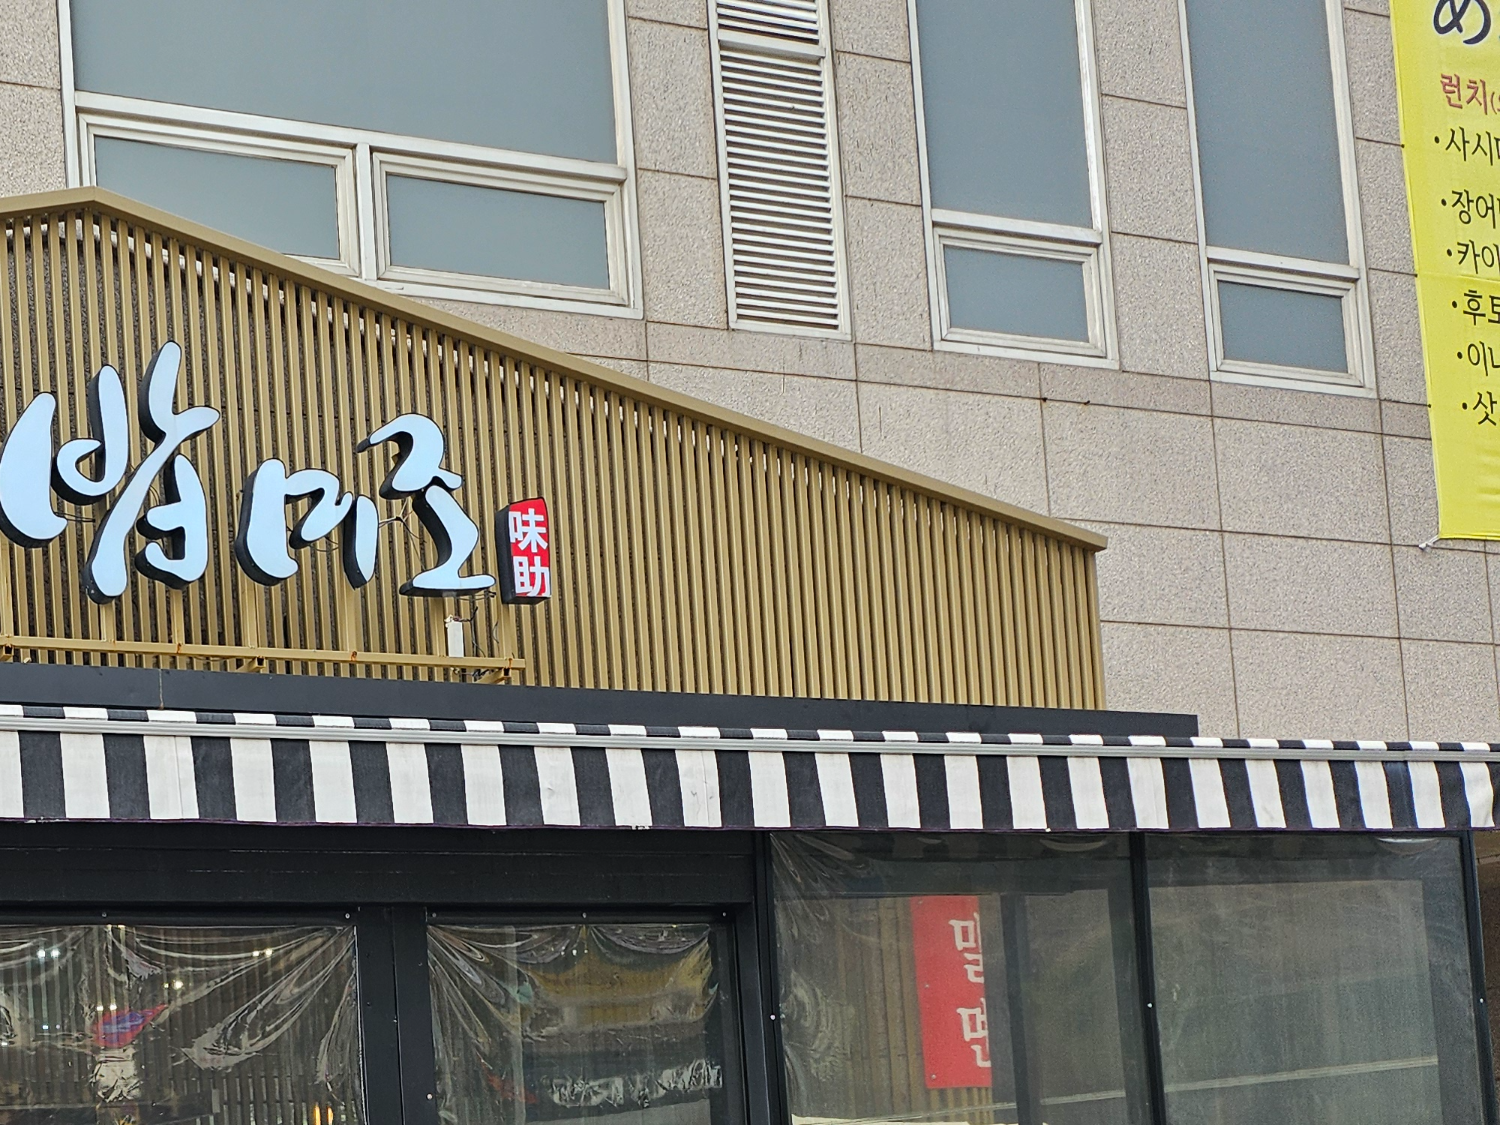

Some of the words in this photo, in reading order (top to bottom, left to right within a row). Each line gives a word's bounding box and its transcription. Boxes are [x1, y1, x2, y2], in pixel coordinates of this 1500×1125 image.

[1439, 72, 1500, 115] 런치(
[1445, 126, 1500, 167] 사시
[1451, 189, 1500, 229] 장어
[508, 507, 552, 597] 味助
